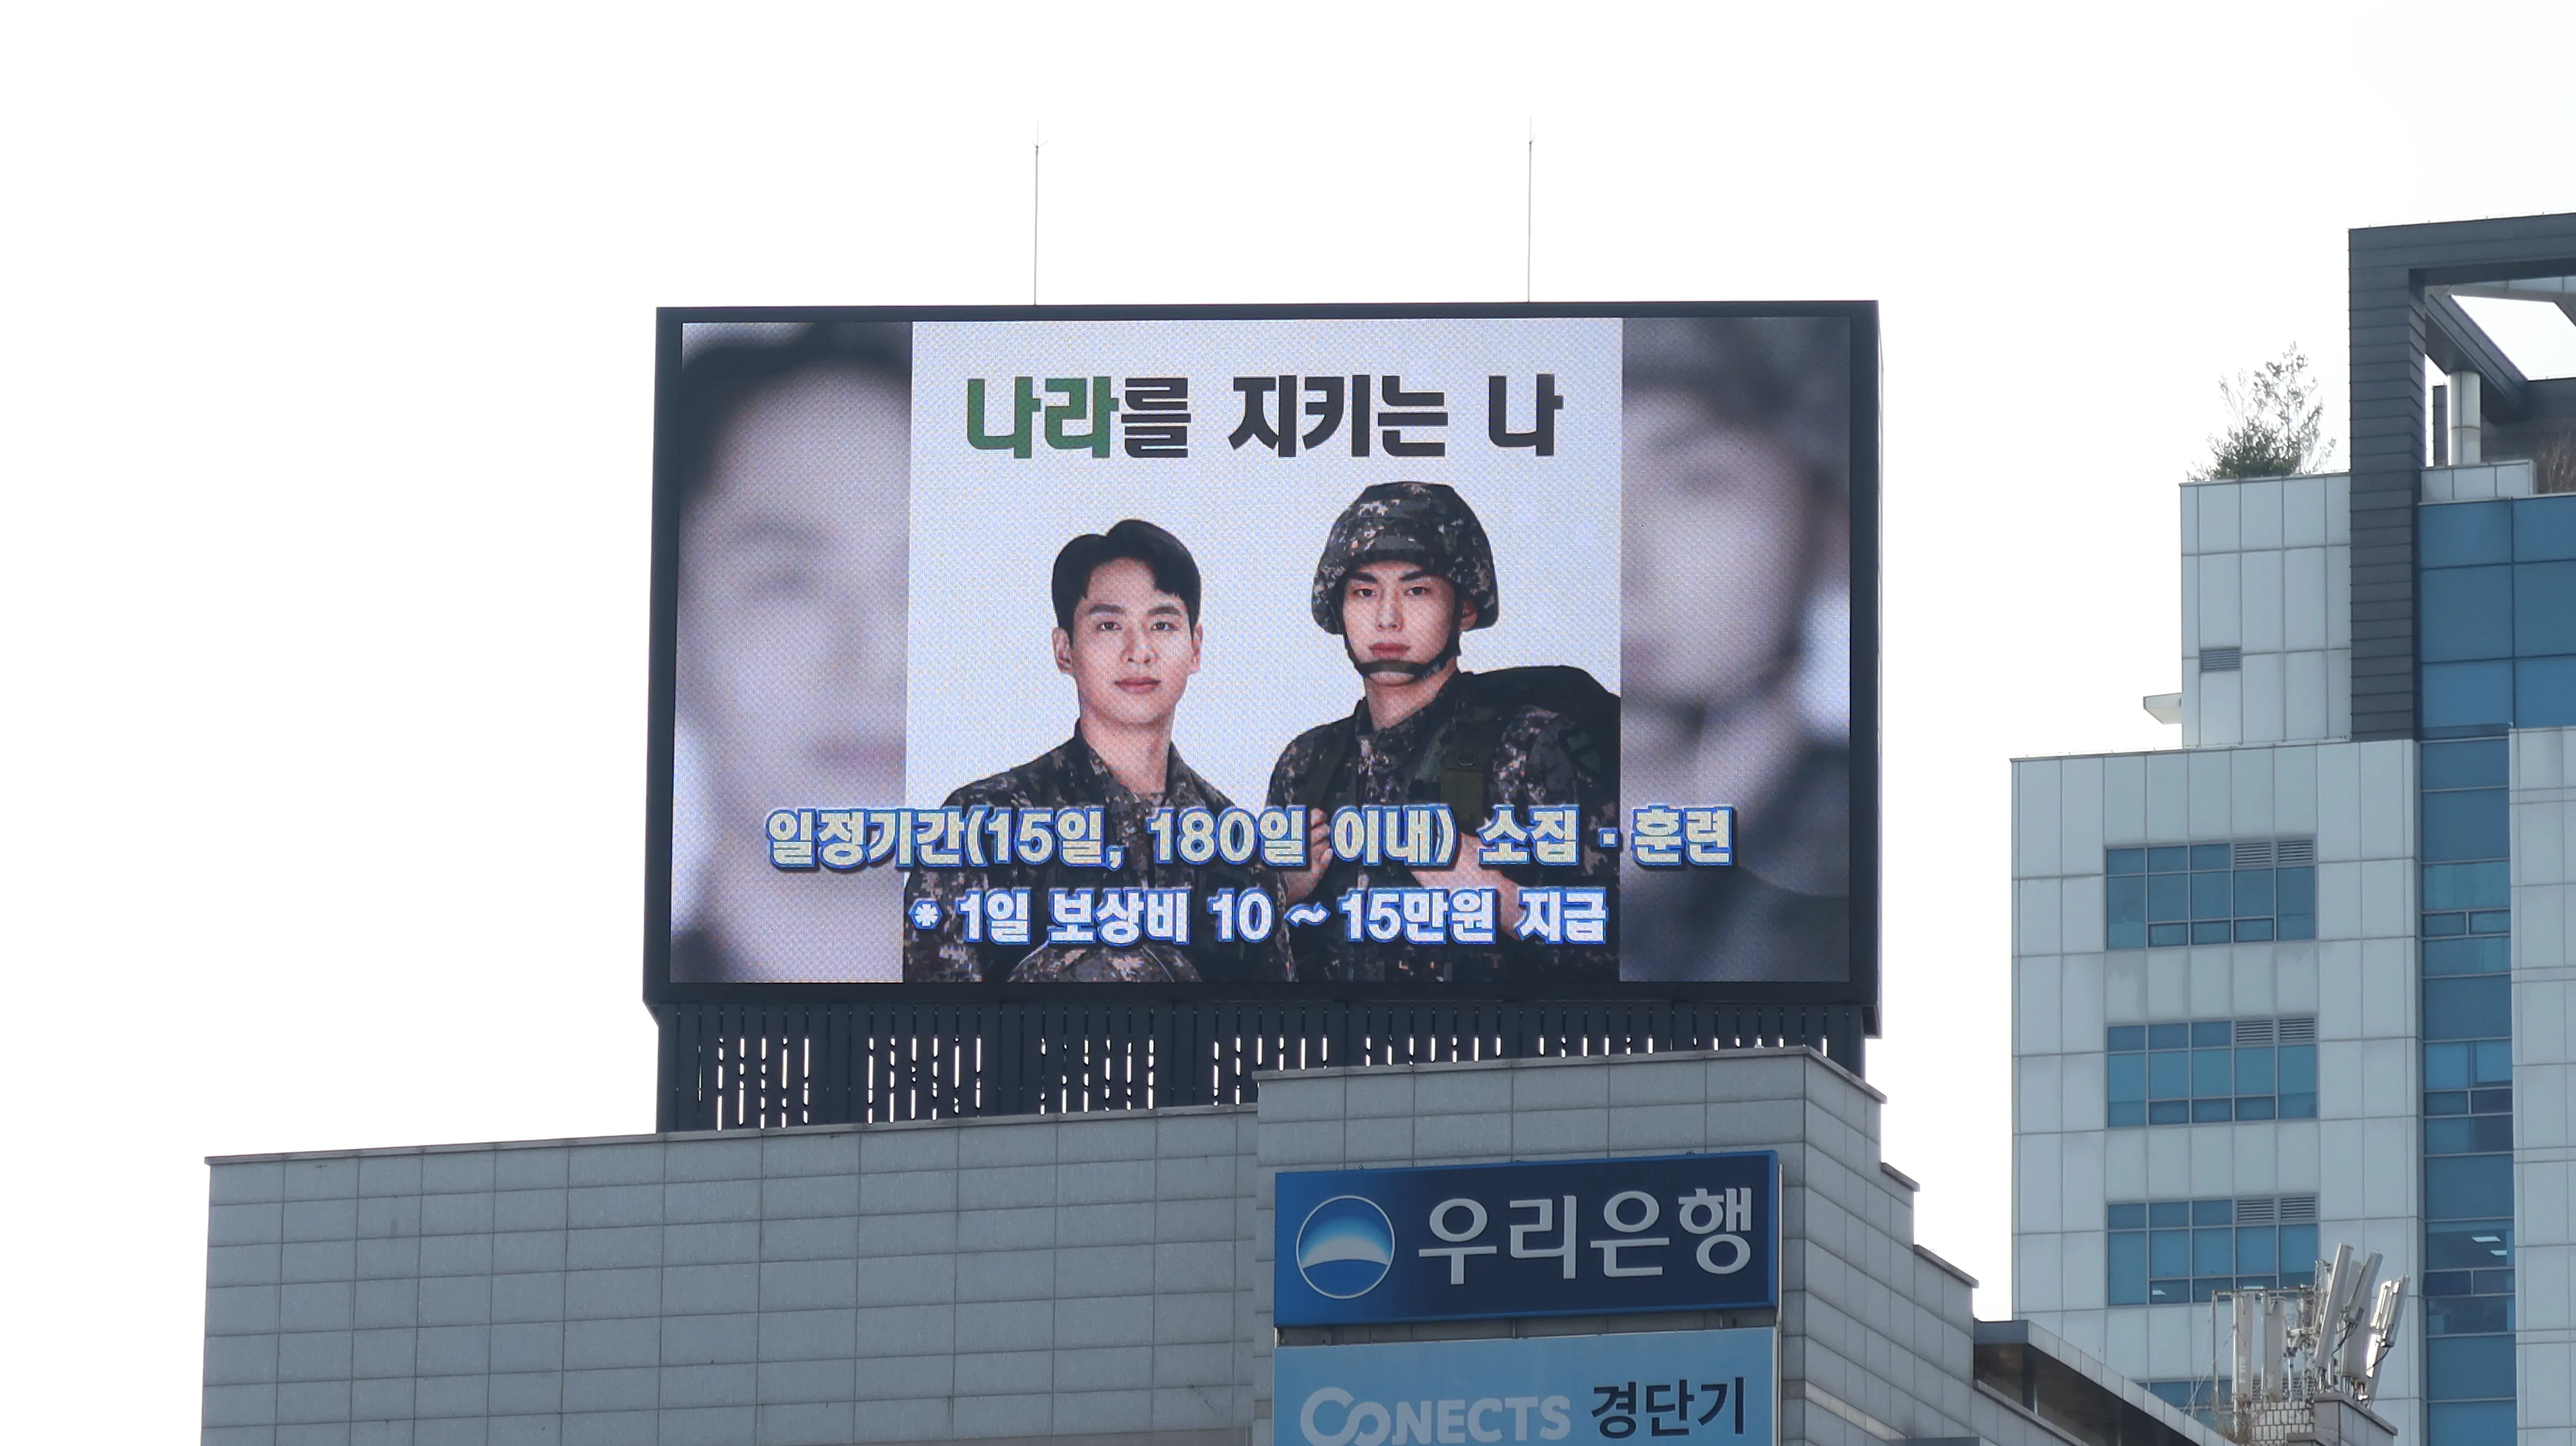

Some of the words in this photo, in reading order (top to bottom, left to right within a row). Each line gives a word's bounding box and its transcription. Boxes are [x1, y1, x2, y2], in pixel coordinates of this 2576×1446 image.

[966, 376, 1191, 458] 나라를
[1228, 374, 1449, 458] 지키는
[1488, 374, 1564, 457] 나
[766, 806, 1123, 870] 일정기간(15일,
[1147, 806, 1305, 866] 180일
[1329, 805, 1457, 866] 이내)
[958, 887, 1030, 943] 1일
[1047, 887, 1191, 946] 보상비
[1516, 887, 1609, 944] 지급
[1418, 1187, 1751, 1285] 우리은행
[1300, 1387, 1571, 1446] CONECTS
[1591, 1377, 1745, 1440] 경단기
